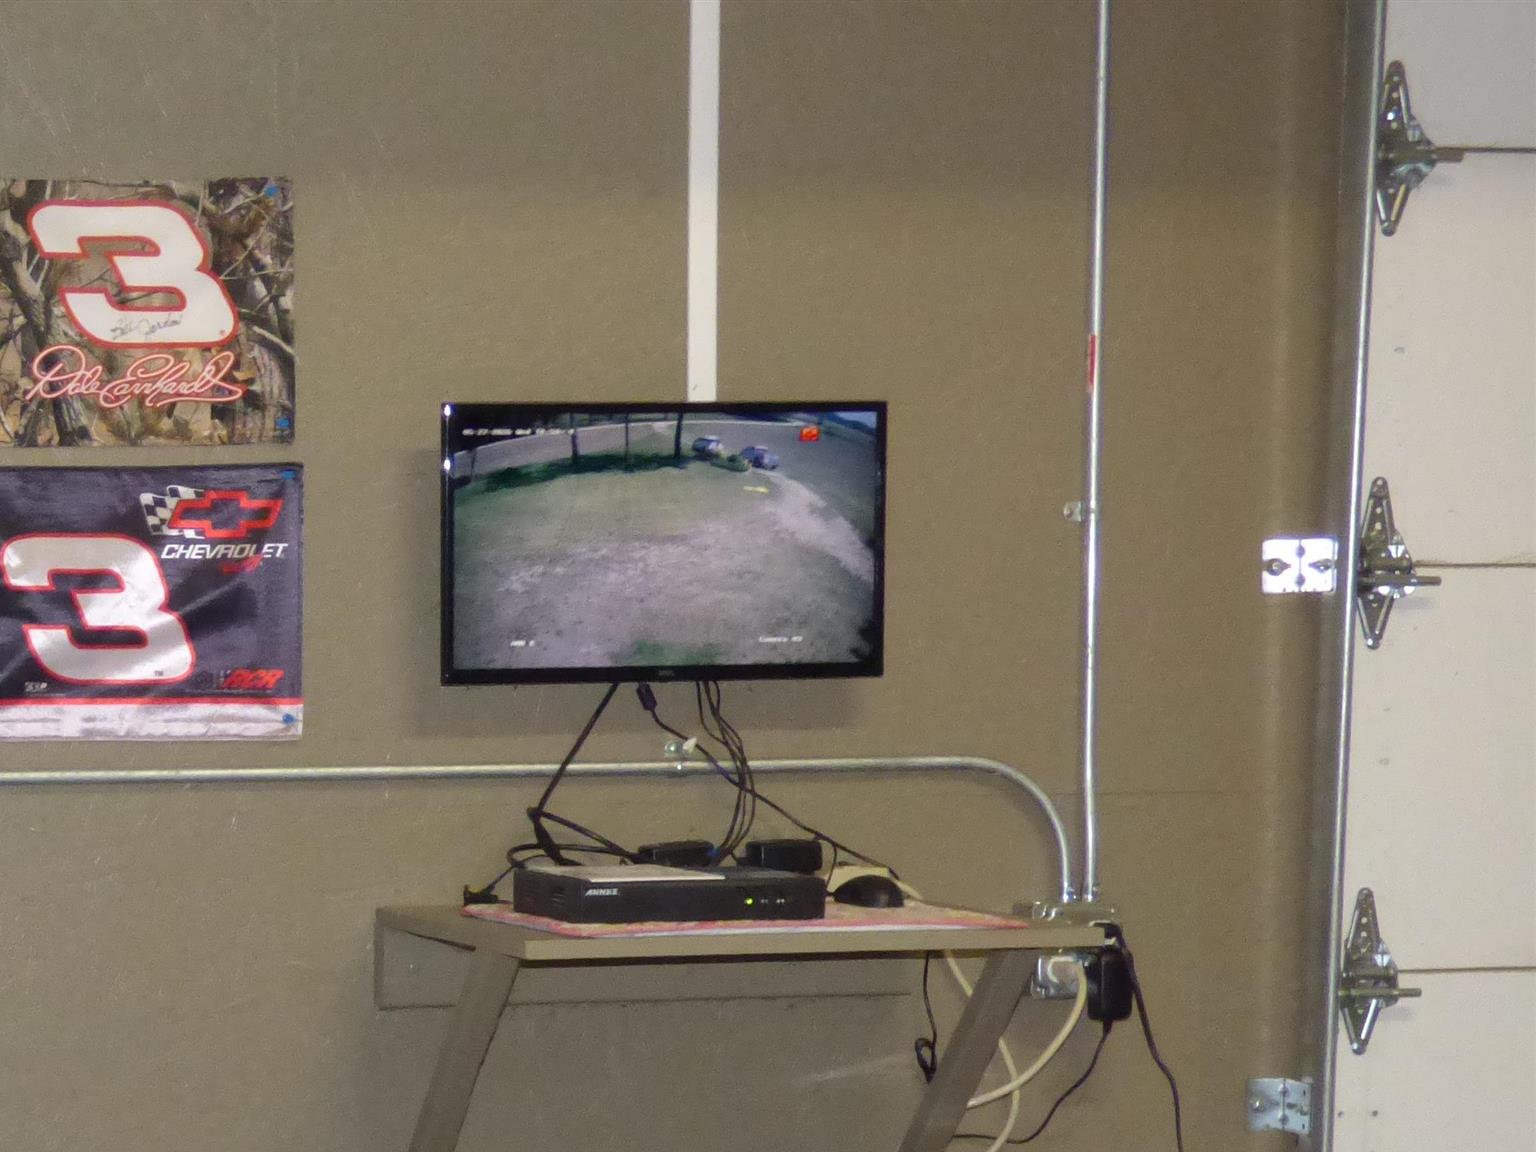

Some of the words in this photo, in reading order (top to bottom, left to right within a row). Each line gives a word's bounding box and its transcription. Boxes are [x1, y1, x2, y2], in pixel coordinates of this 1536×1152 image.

[26, 199, 240, 350] 3
[25, 344, 105, 402] Dale
[160, 542, 289, 560] CHEVROLET
